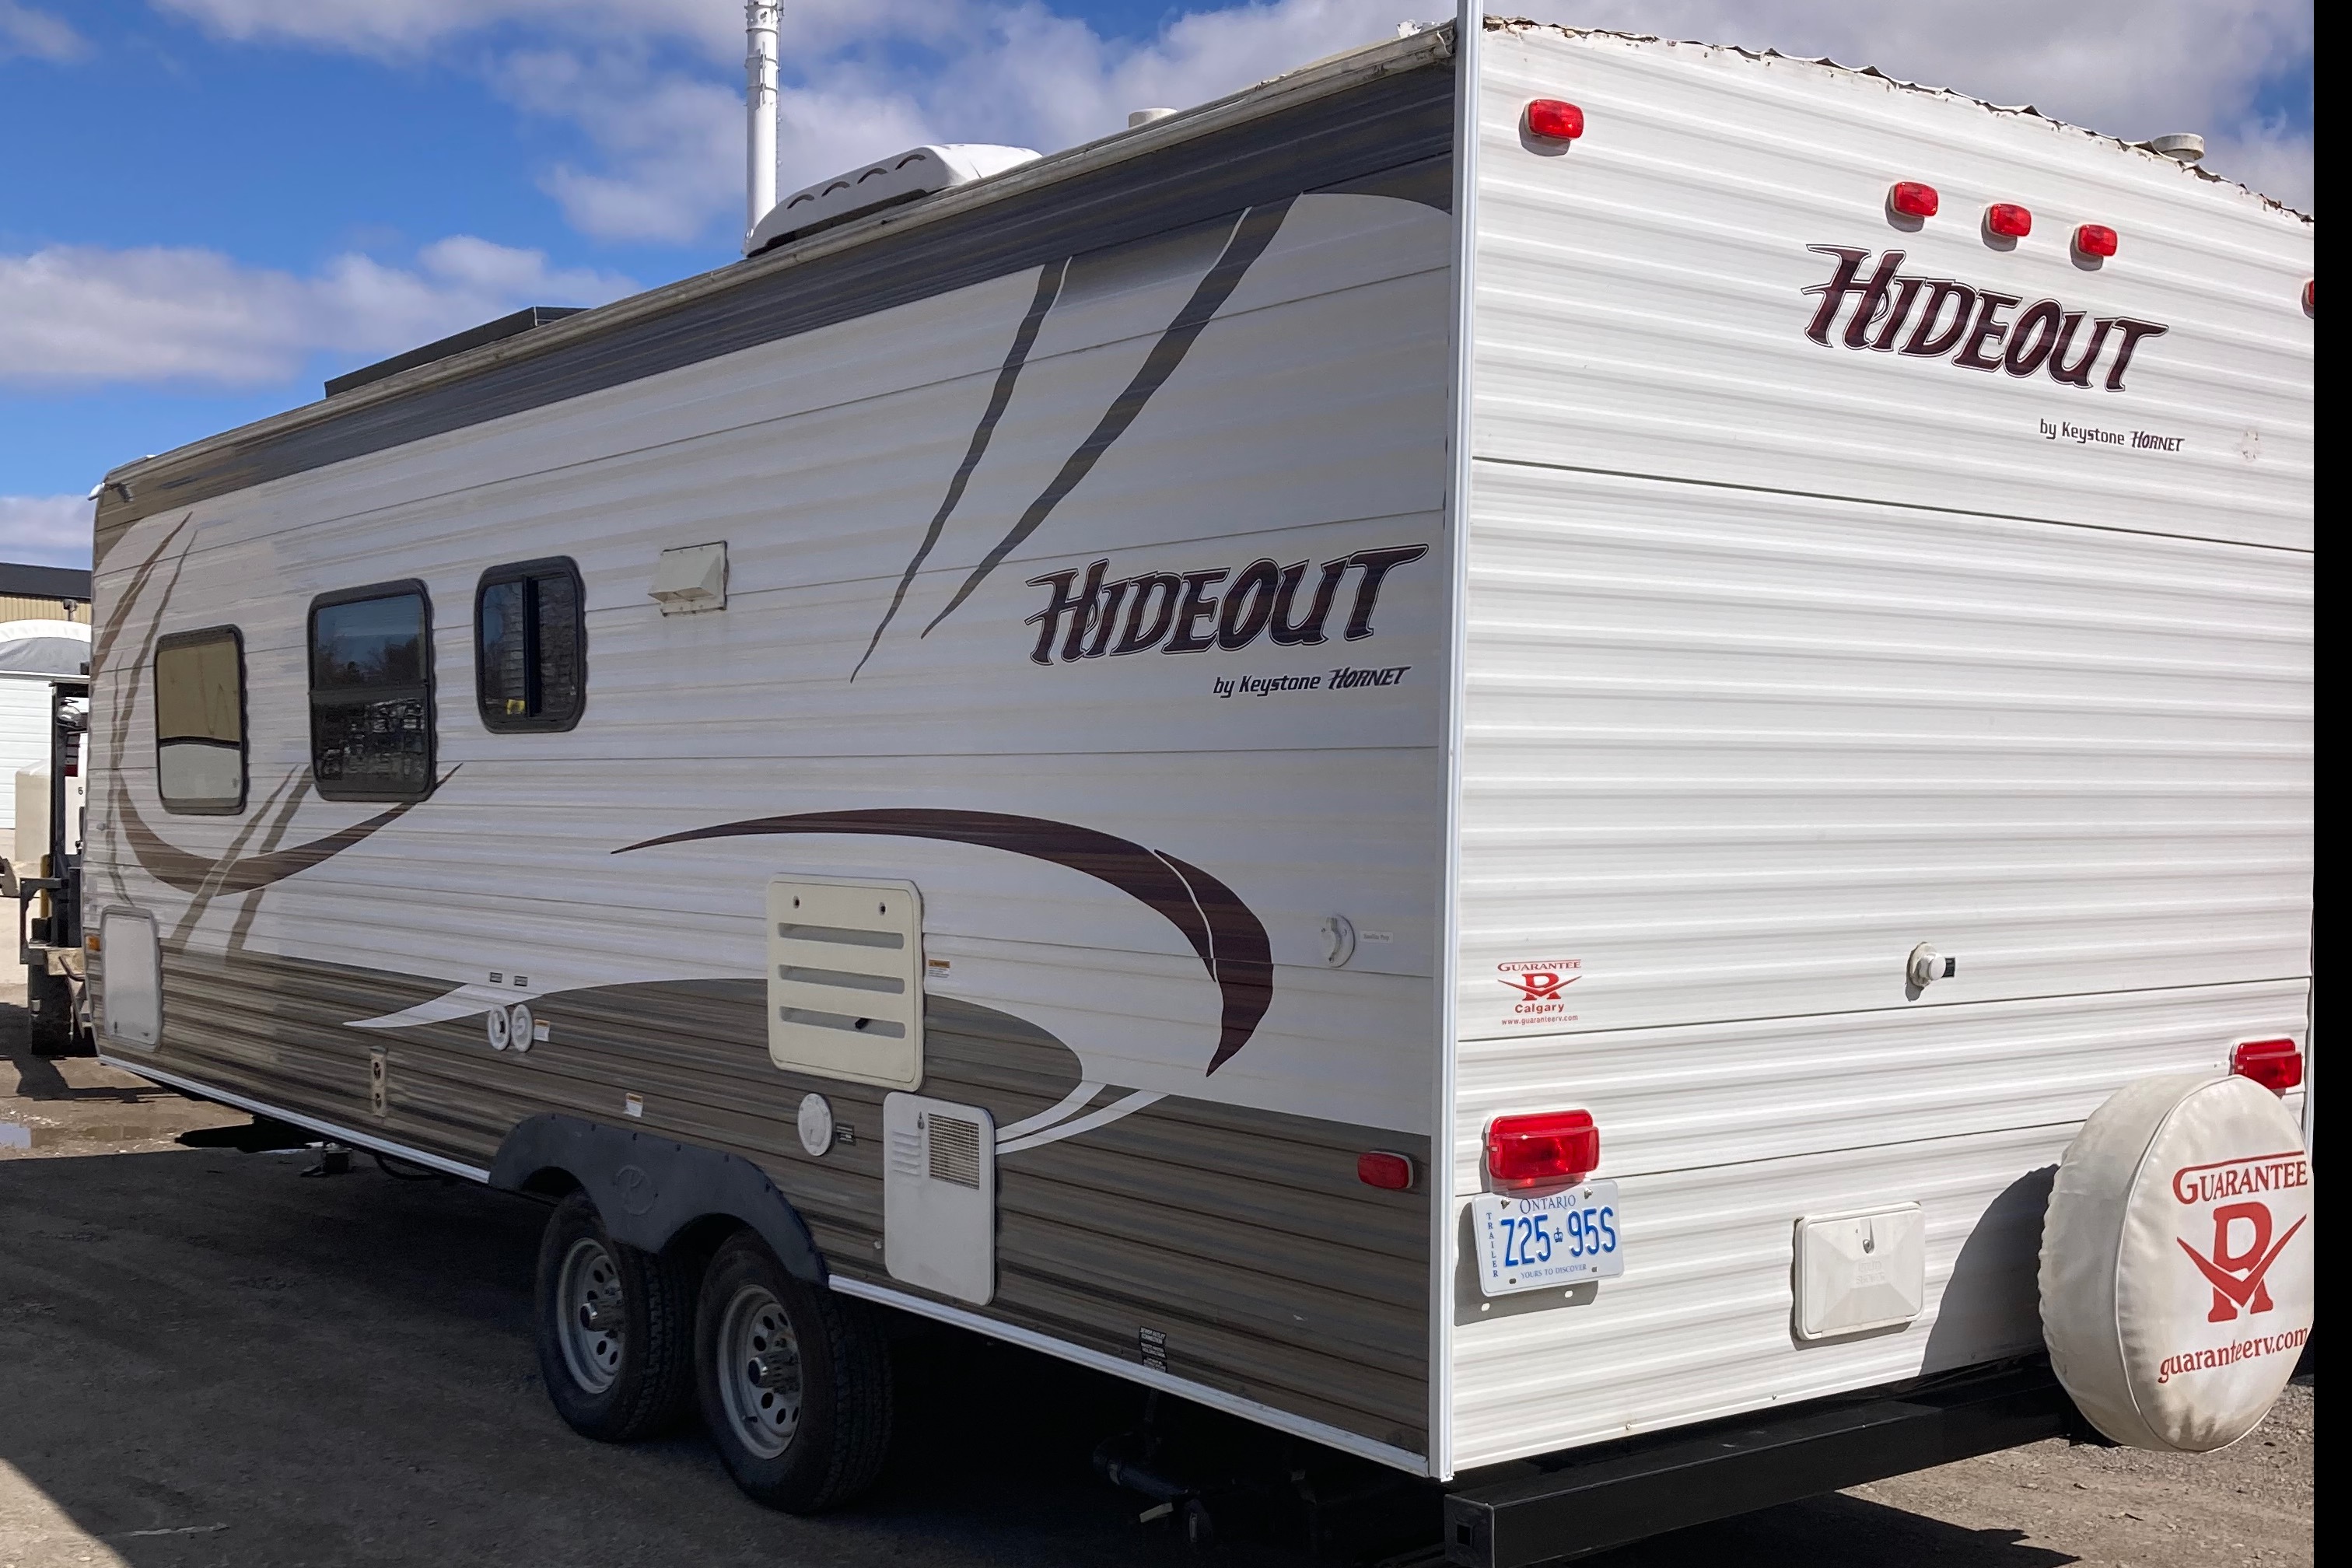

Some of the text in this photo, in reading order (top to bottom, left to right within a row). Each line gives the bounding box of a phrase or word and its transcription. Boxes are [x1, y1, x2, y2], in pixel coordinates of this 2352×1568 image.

[1801, 244, 2168, 392] HIDEOUT
[2039, 418, 2186, 452] by Keystone HORNET
[1024, 544, 1430, 666] HIDEOUT
[1213, 666, 1412, 698] by Keystone HORNET
[1497, 959, 1582, 971] GUARANTEE
[1501, 1014, 1579, 1026] www.guaranteerv.com
[1514, 1003, 1565, 1014] Calgary
[2172, 1150, 2308, 1205] GUARANTEE
[1519, 1194, 1577, 1214] ONTARIO
[1486, 1213, 1499, 1278] TRAILER
[1521, 1263, 1587, 1279] YOURS TO DISCOVER
[2158, 1327, 2309, 1384] guaranteerv.com
